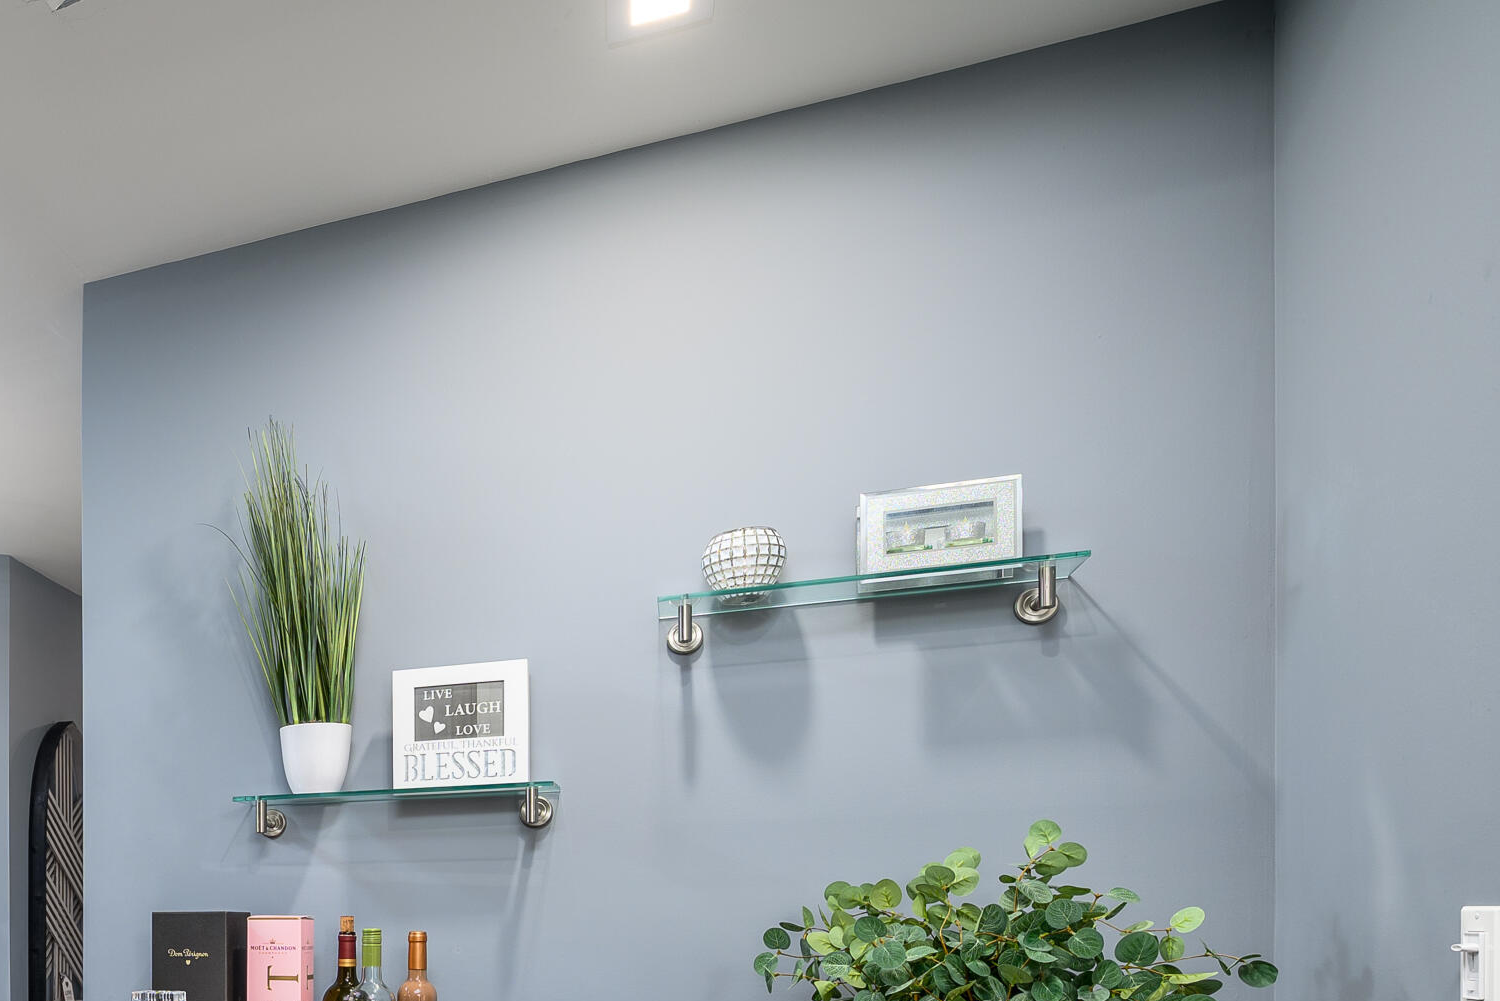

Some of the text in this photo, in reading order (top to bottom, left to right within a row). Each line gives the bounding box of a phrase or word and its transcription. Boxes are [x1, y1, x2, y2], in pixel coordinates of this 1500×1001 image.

[423, 688, 453, 701] LIVE
[444, 700, 502, 717] LAUGH
[455, 723, 491, 736] LOVE
[403, 748, 517, 782] BLESSED
[168, 948, 183, 957] Dom
